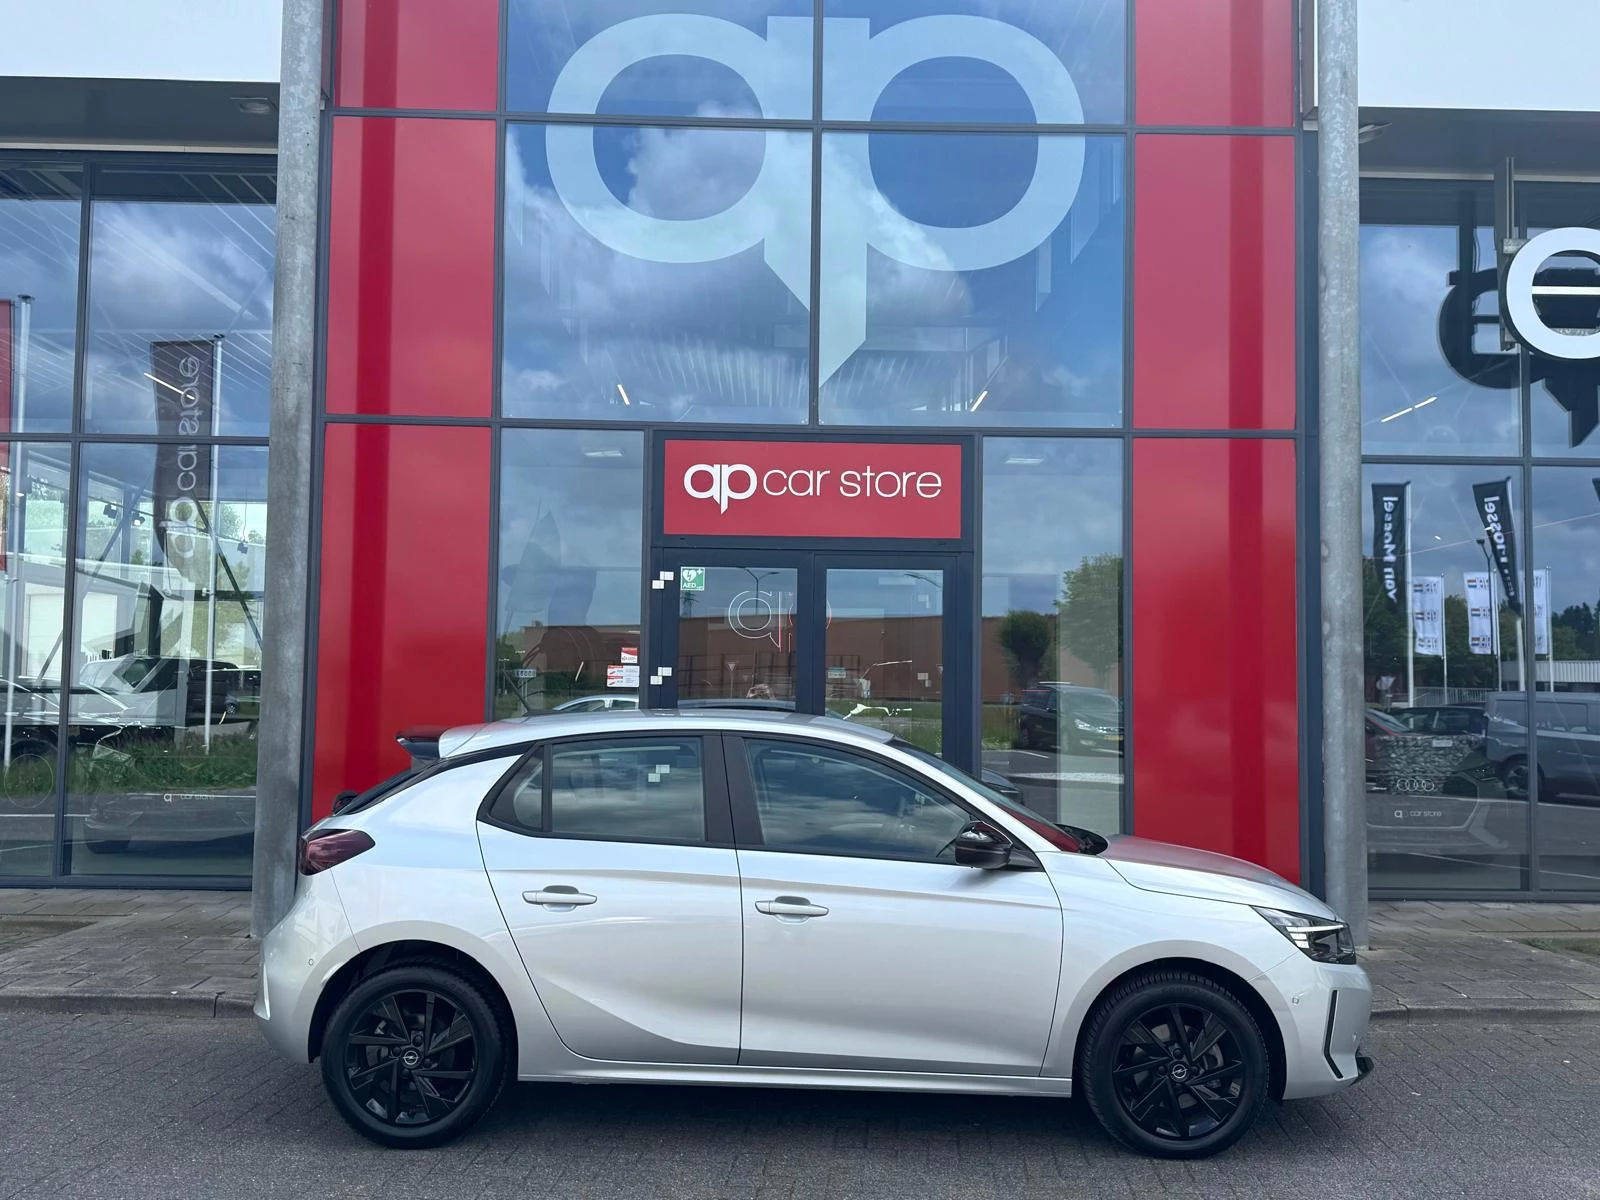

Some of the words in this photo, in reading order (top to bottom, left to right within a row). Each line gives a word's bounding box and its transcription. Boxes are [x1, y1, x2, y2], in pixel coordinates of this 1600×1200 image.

[683, 463, 758, 514] ap
[763, 469, 830, 497] car
[840, 465, 942, 498] store
